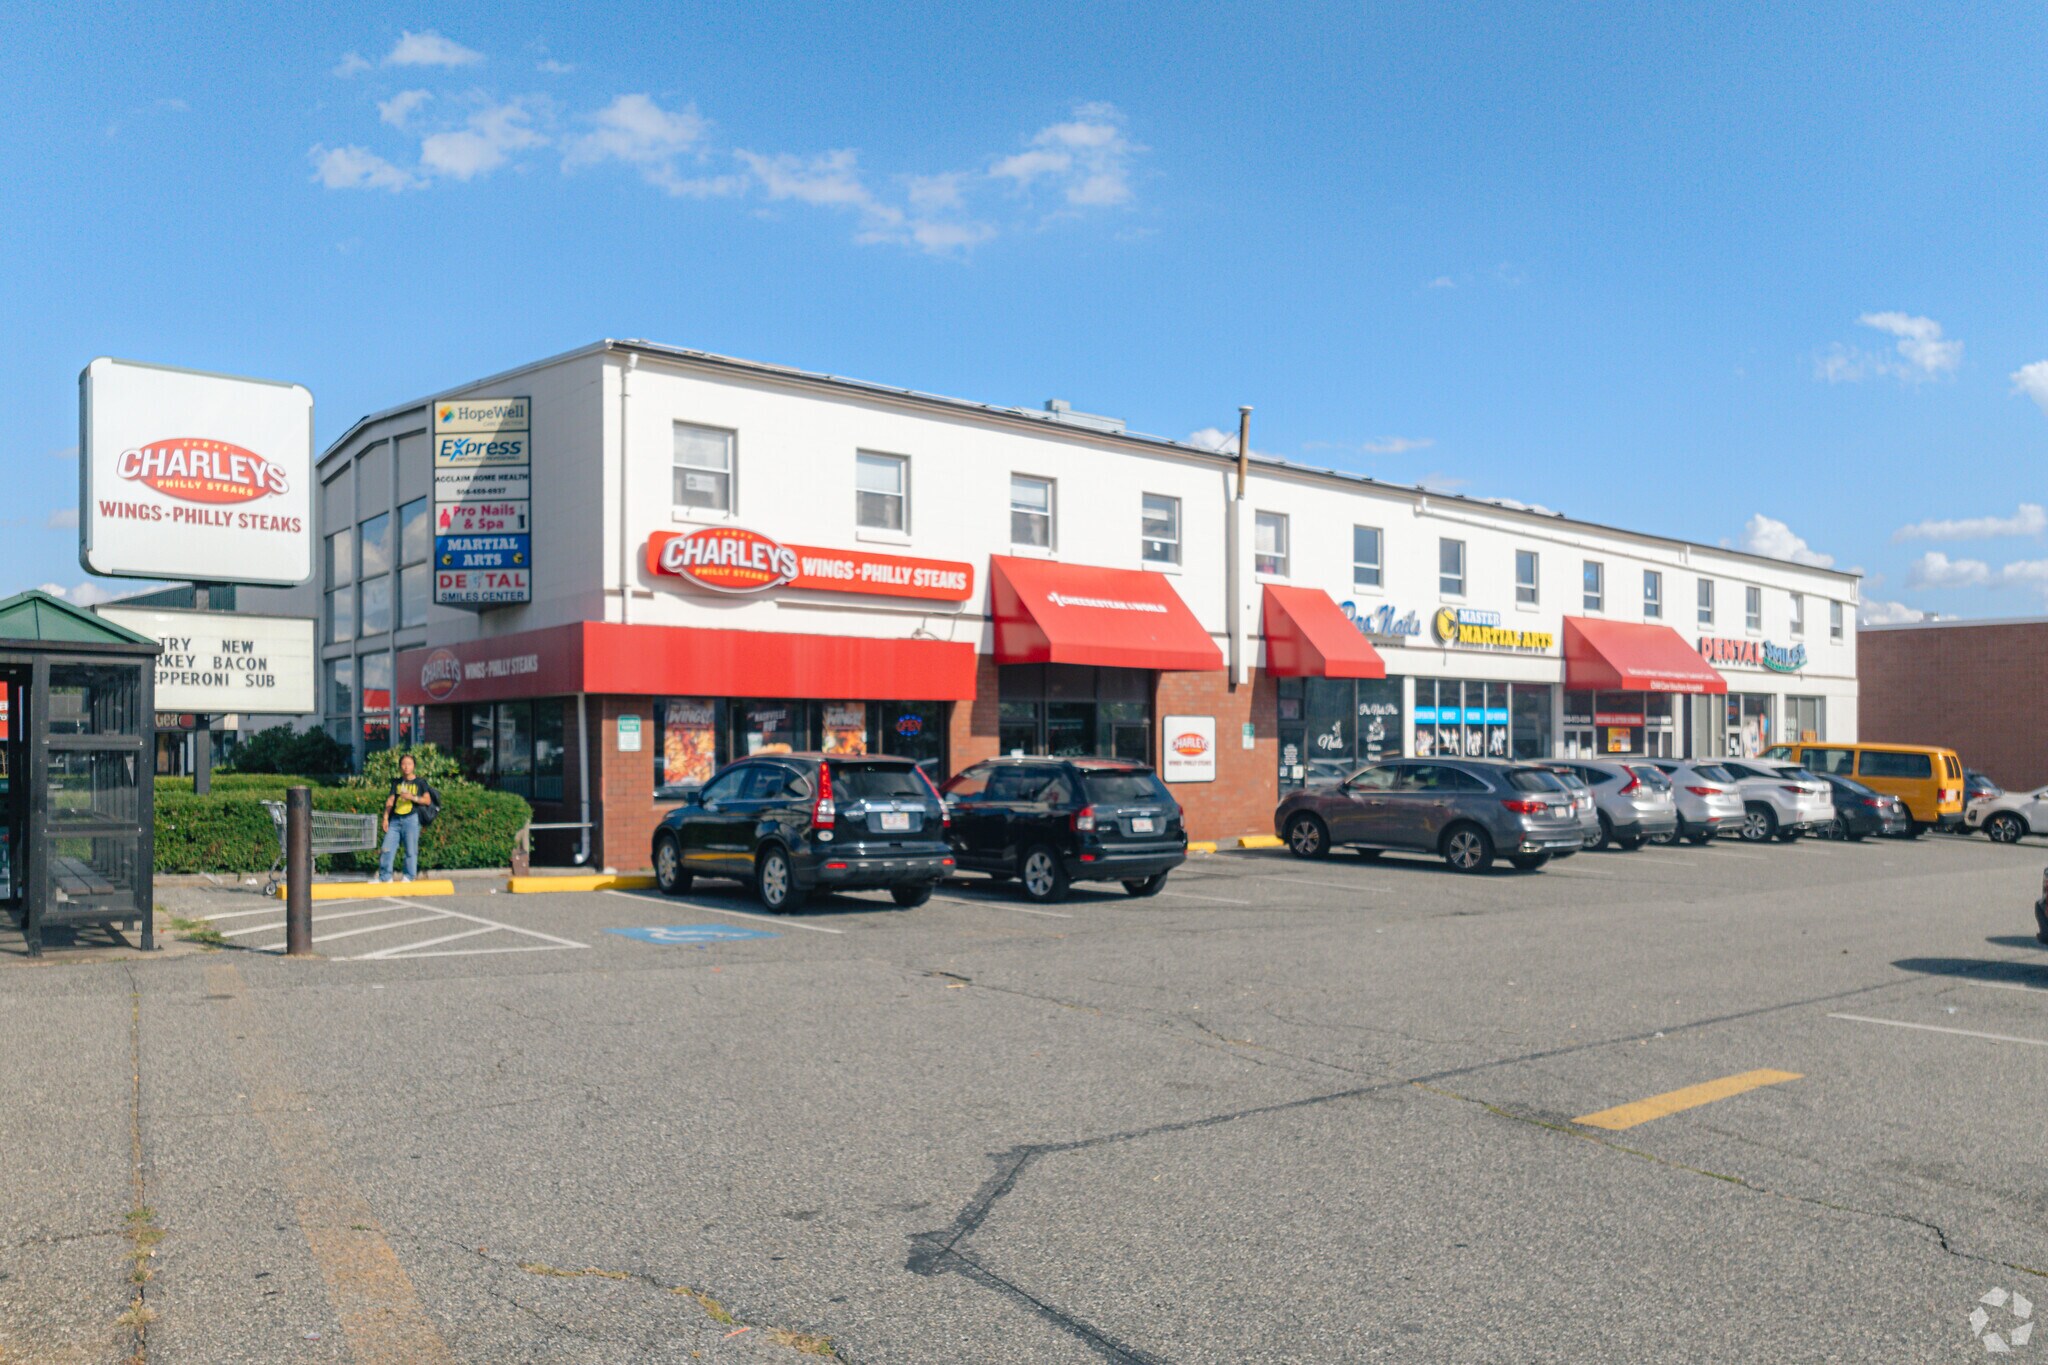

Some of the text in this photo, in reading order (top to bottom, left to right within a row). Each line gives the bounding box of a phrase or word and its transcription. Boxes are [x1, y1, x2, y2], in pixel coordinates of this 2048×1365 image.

[458, 405, 524, 420] HopeWell
[440, 438, 521, 461] Express
[117, 448, 289, 495] CHARLEYS
[157, 479, 254, 497] PHILLY STEAKS
[453, 504, 515, 516] Pro Nails
[238, 512, 301, 534] STEAKS
[464, 518, 504, 531] & Spa
[447, 537, 518, 551] MARTIAL
[463, 553, 502, 566] ARTS
[666, 538, 797, 579] CHARLEYS
[913, 568, 967, 590] STEAKS
[441, 591, 525, 602] SMILES CENTER
[1375, 604, 1421, 637] Nails
[1459, 609, 1501, 625] MASTER
[1459, 624, 1554, 648] MARTIAL ARTS
[222, 640, 254, 654] NEW
[1700, 637, 1763, 664] DENTAL
[155, 654, 267, 671] RKEY BACON
[245, 674, 275, 688] SUB
